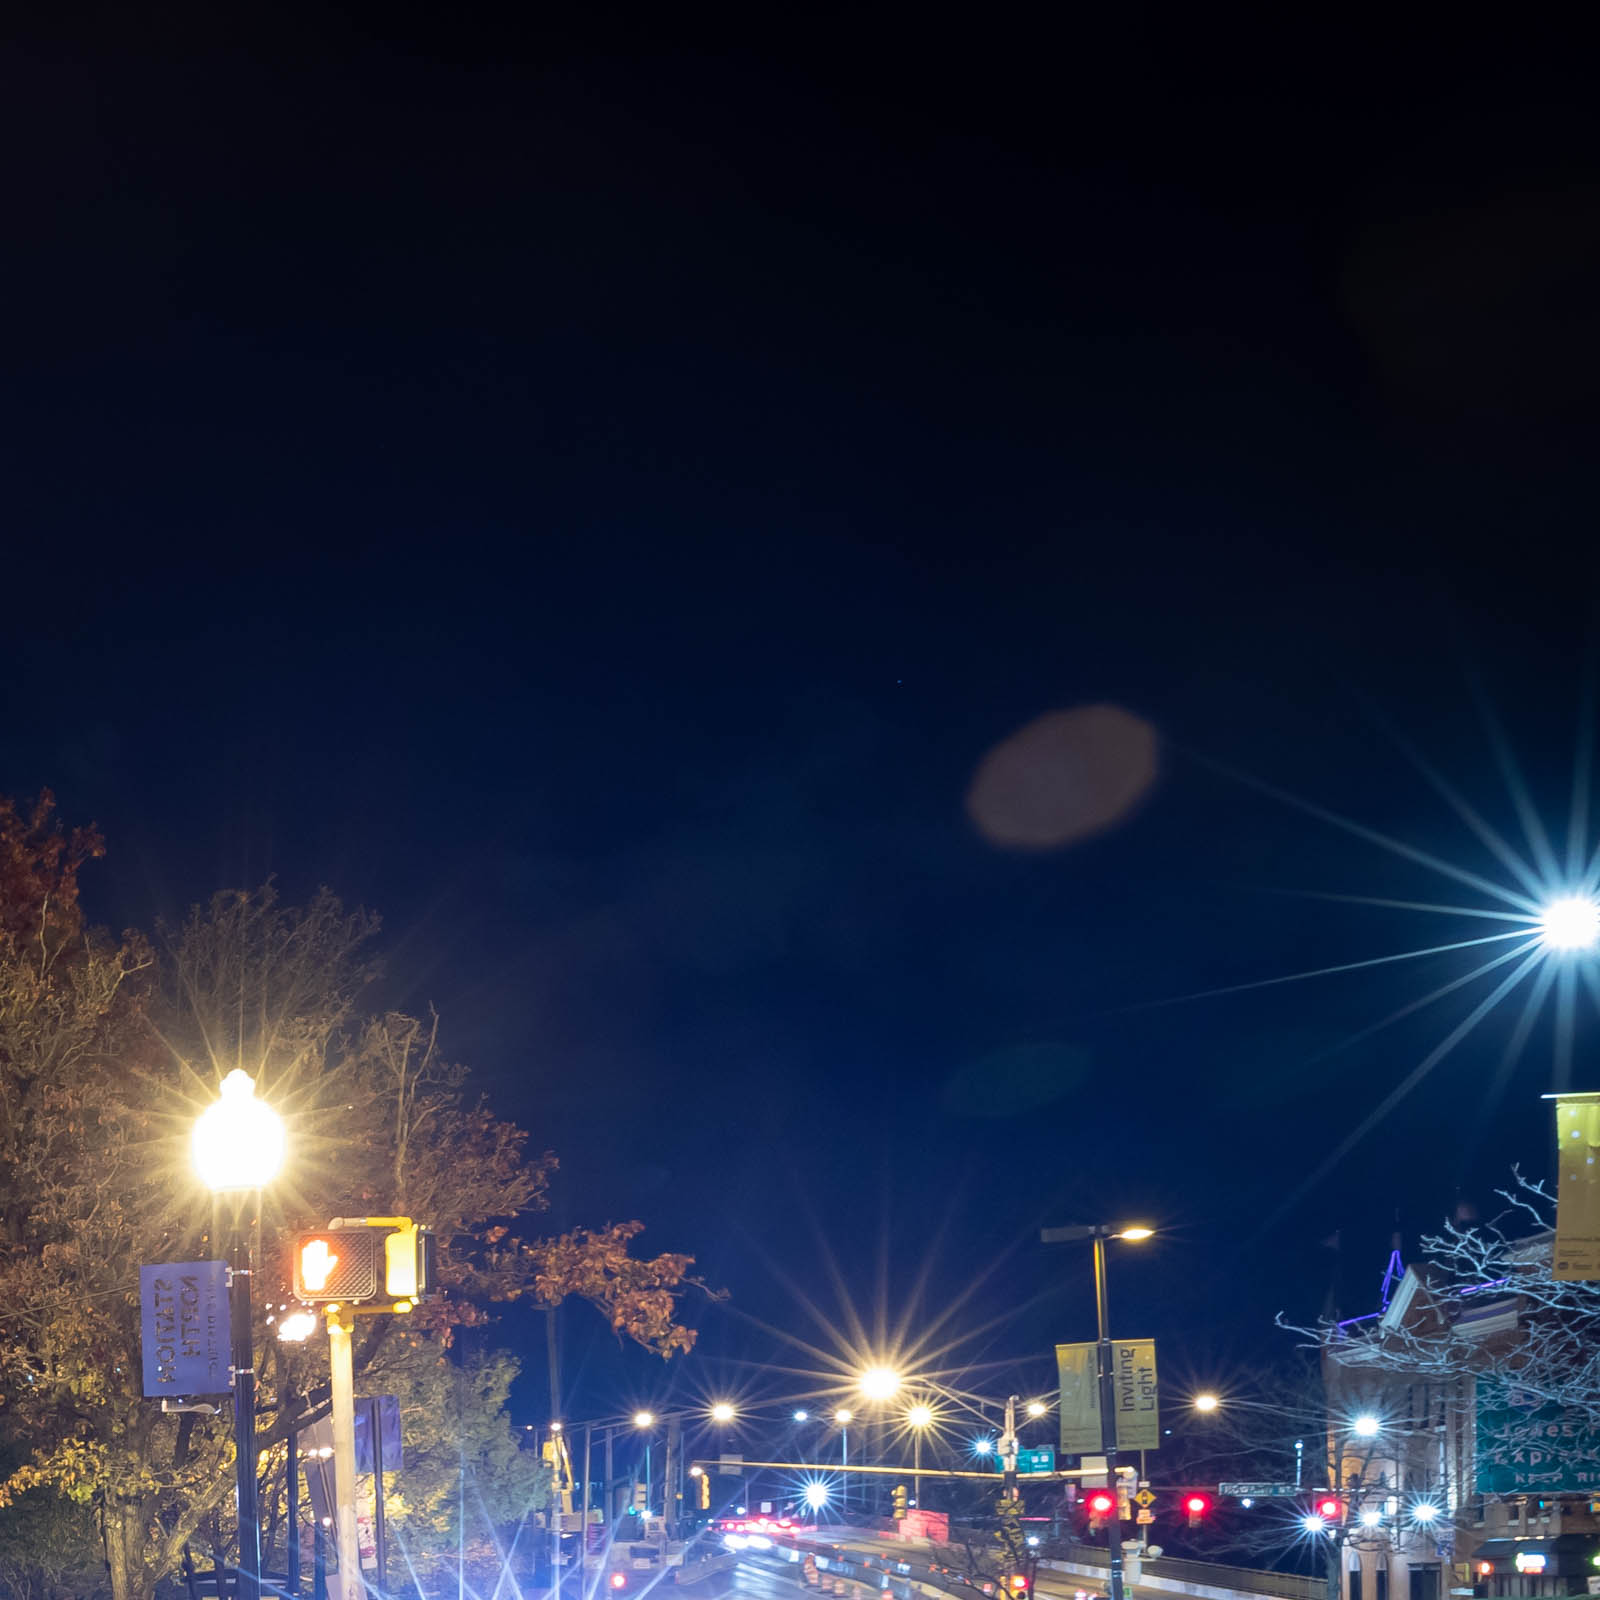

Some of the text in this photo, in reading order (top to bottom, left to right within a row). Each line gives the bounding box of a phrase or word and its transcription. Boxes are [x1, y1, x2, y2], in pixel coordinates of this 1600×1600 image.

[1119, 1348, 1136, 1411] Inviting
[1137, 1367, 1157, 1411] Light
[1577, 1471, 1600, 1483] RI
